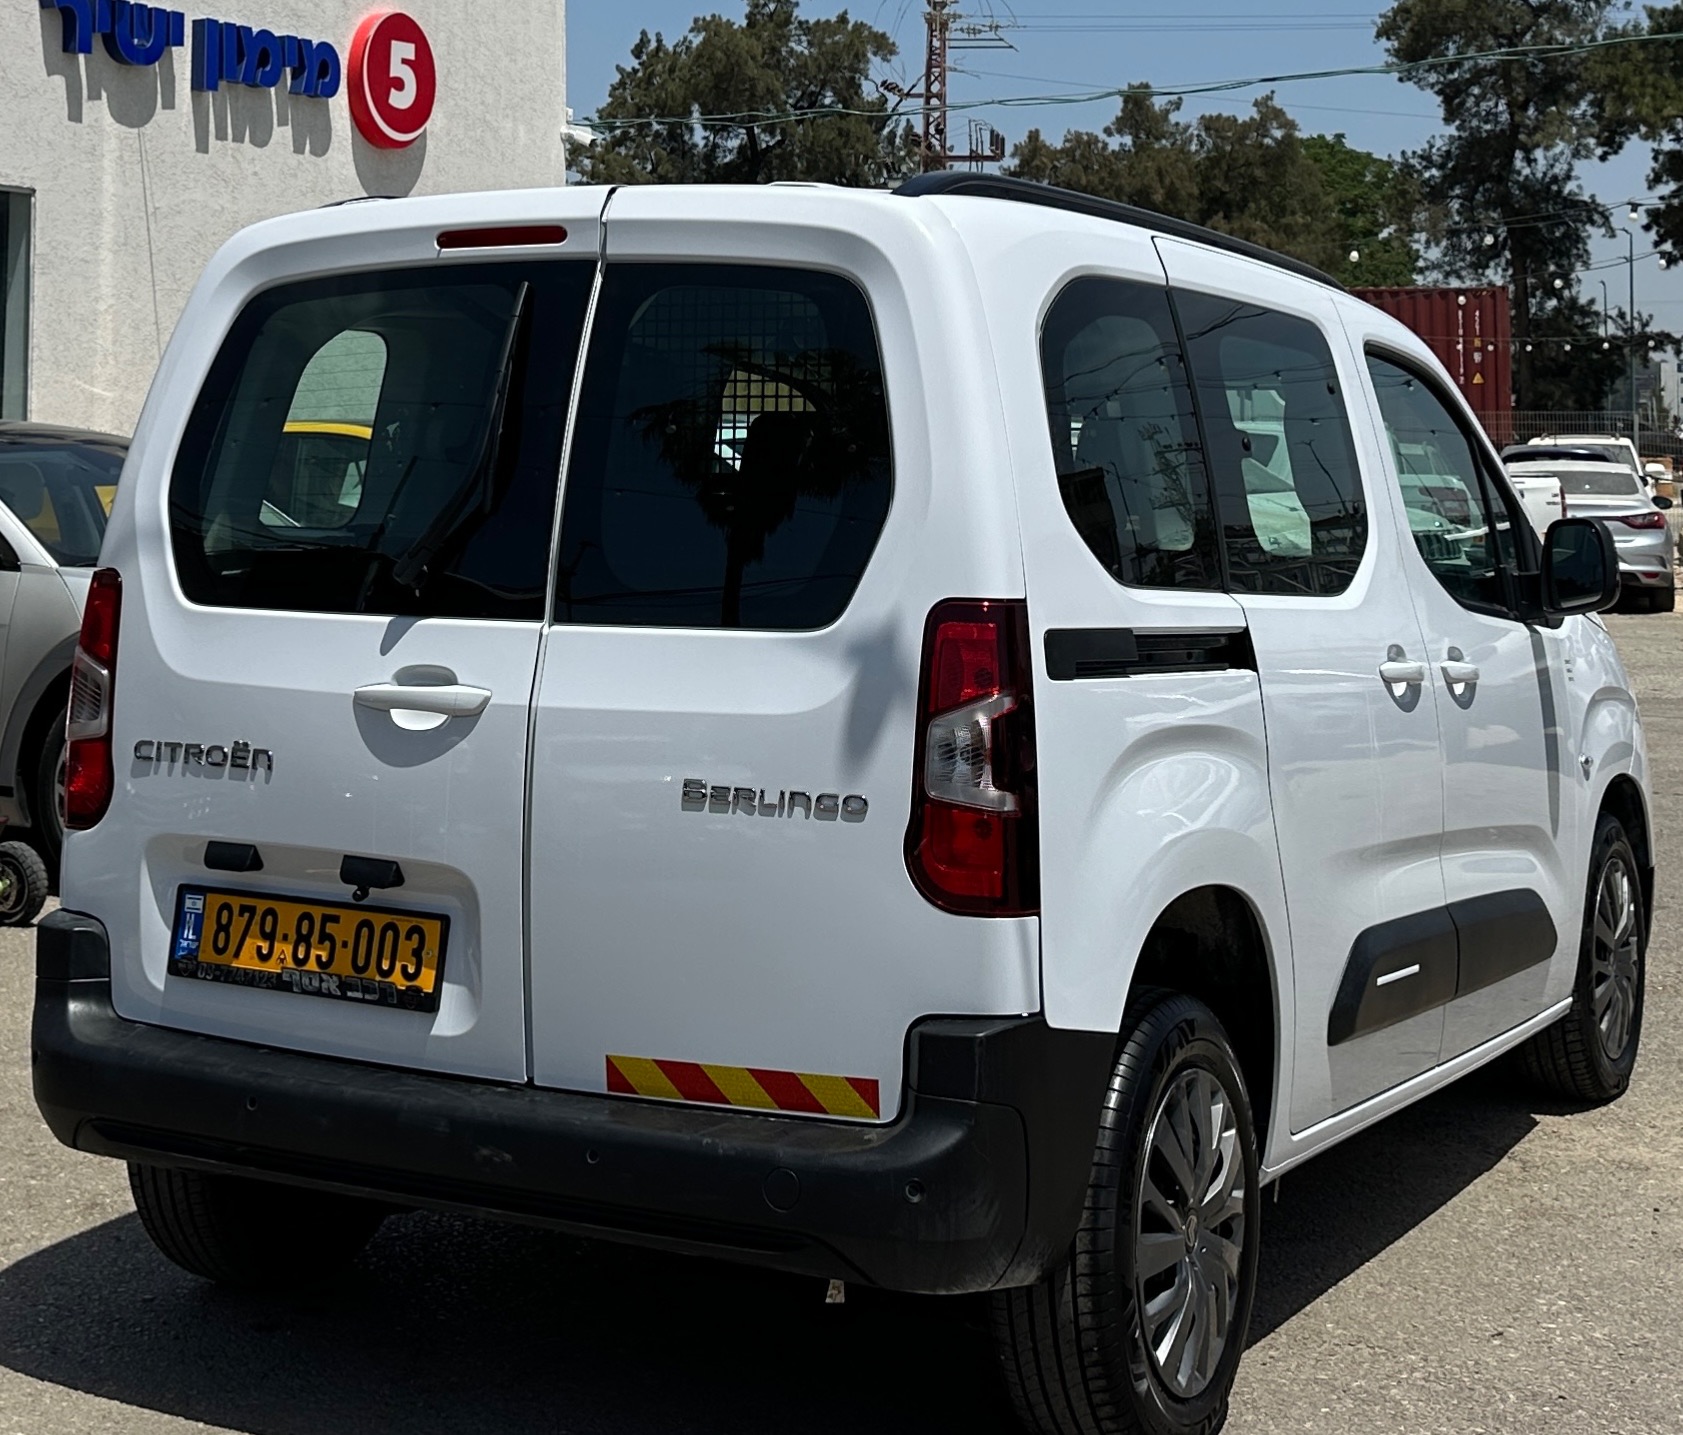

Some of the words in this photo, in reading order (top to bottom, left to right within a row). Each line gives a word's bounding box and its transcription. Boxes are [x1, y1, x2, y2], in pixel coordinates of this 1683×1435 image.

[192, 18, 341, 98] מימון
[388, 40, 417, 110] 5
[134, 740, 273, 771] CITROËN
[183, 912, 197, 939] IL
[282, 968, 341, 996] אסף
[344, 976, 398, 1004] רכב
